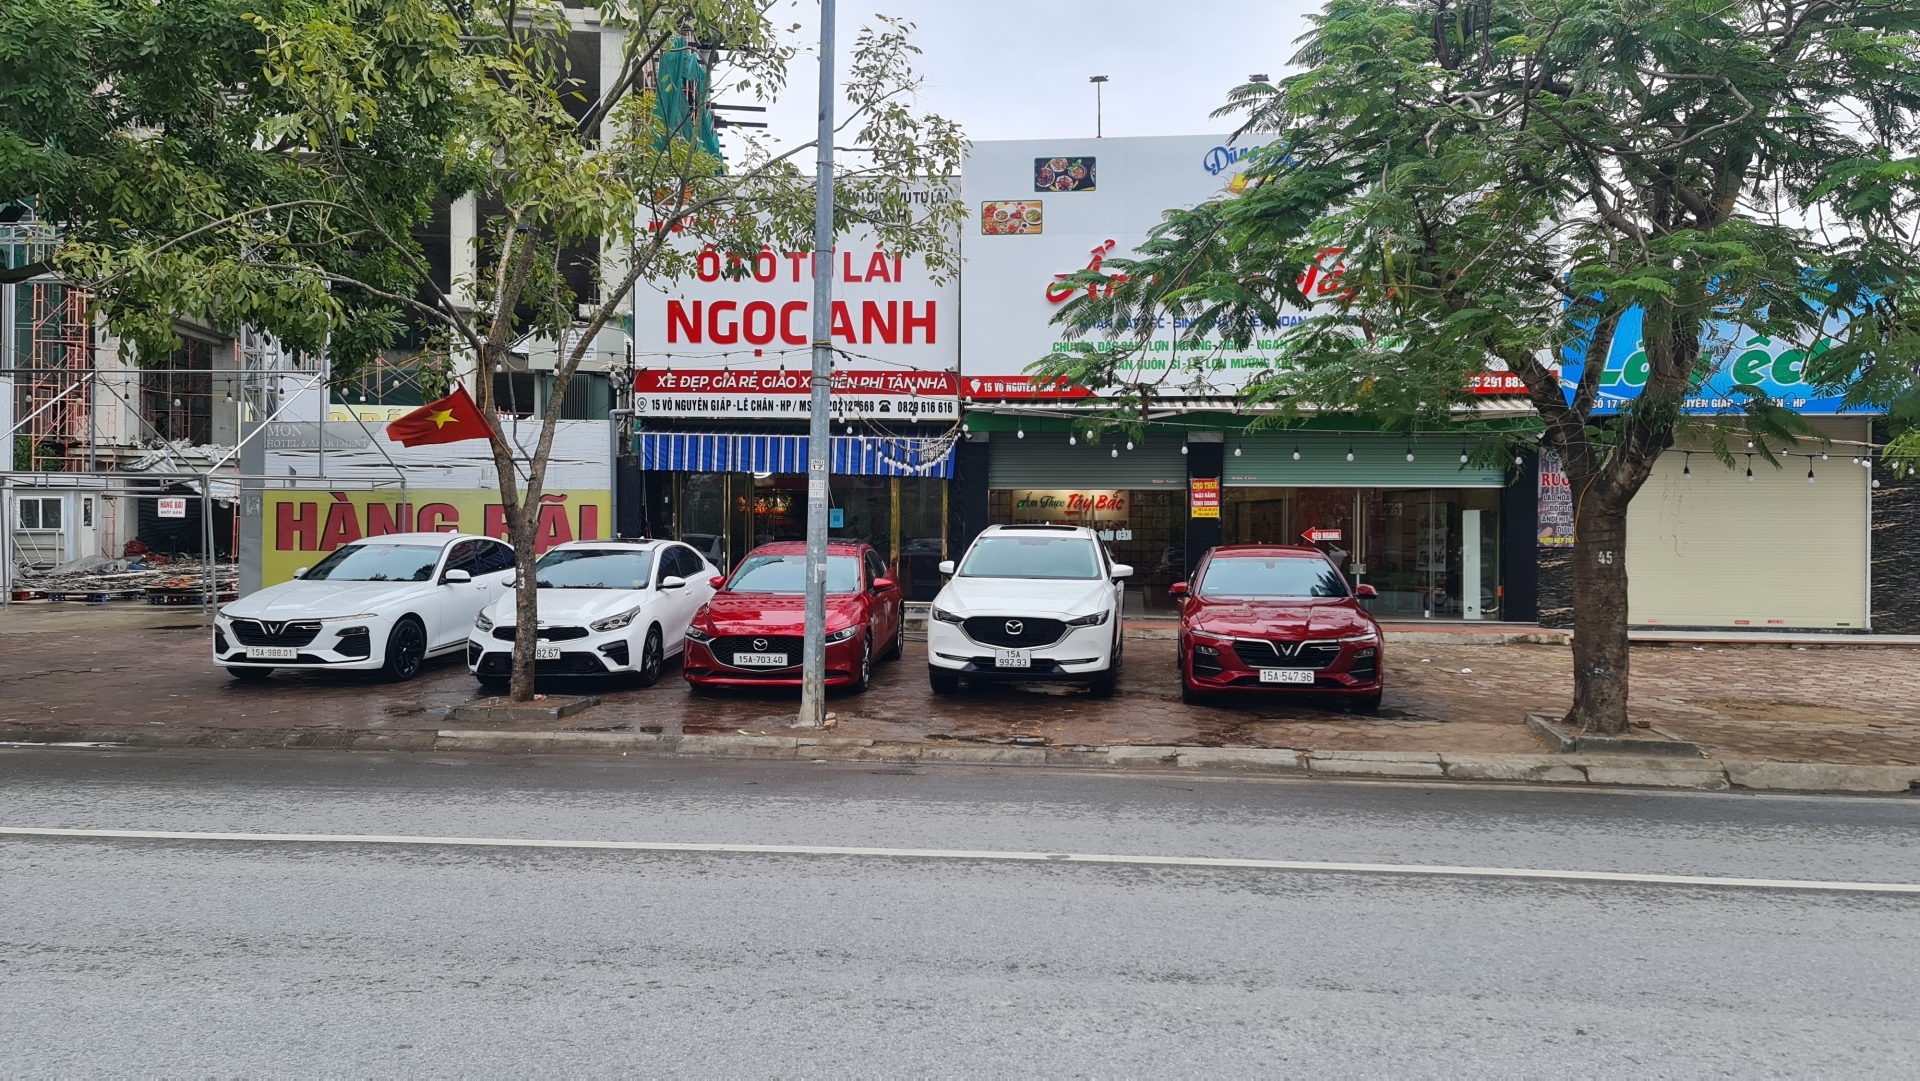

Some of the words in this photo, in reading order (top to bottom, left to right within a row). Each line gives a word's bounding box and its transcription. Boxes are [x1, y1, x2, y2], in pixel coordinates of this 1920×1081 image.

[843, 242, 902, 283] LÁI
[667, 300, 808, 357] NGỌC
[830, 300, 936, 344] ANH
[1149, 340, 1169, 353] LỢN
[680, 375, 711, 392] ĐẸP,
[712, 373, 737, 388] GIÁ
[738, 371, 760, 390] RẺ,
[860, 373, 885, 390] PHÍ
[916, 374, 948, 390] NHÀ
[983, 382, 992, 392] 15
[1484, 376, 1502, 388] 291
[652, 398, 660, 410] 15
[710, 396, 731, 412] GIÁP
[737, 396, 748, 412] LÊ
[750, 397, 774, 412] CHÂN
[780, 400, 792, 412] HP
[898, 401, 918, 412] 0829
[921, 402, 935, 412] 616
[938, 402, 953, 413] 616
[1606, 399, 1618, 408] 17
[1792, 398, 1806, 408] HP
[267, 424, 302, 436] MON
[266, 439, 300, 448] HOTEL
[276, 491, 459, 551] HÀNG
[1598, 551, 1613, 564] 45
[738, 656, 783, 664] 15A-703.40
[999, 658, 1027, 666] 992.93
[1263, 670, 1313, 682] 15A-547.96
